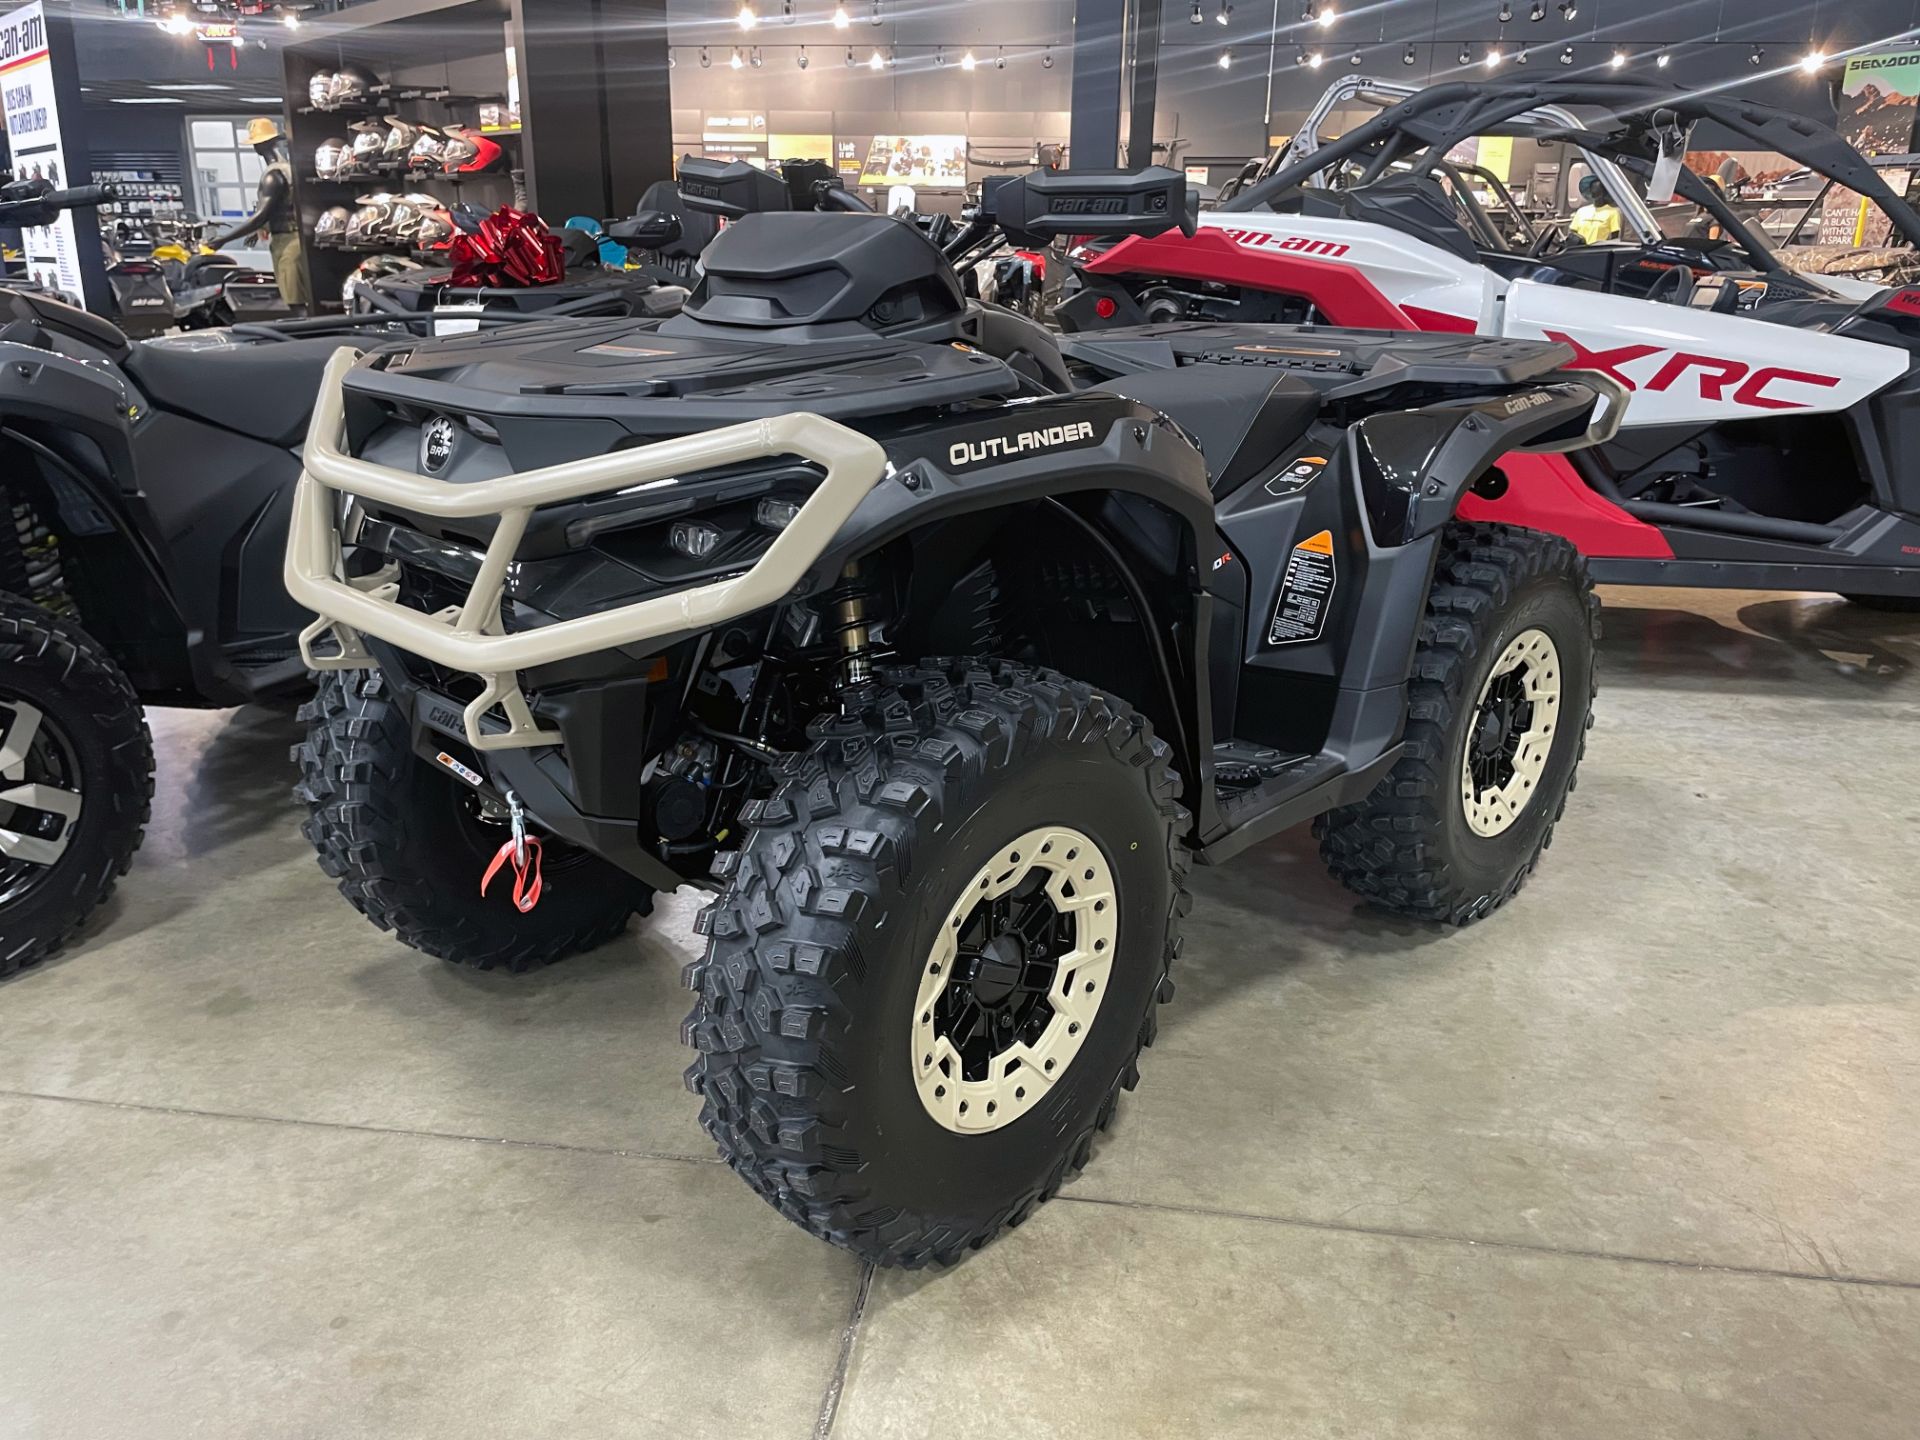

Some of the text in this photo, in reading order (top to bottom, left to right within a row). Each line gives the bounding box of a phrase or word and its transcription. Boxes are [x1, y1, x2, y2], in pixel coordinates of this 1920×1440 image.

[1051, 198, 1124, 213] can-am
[1825, 208, 1873, 217] CAN'T HAE
[1823, 217, 1857, 226] A BLAST
[1822, 227, 1856, 236] WITHOU
[1226, 229, 1350, 257] an-am
[1820, 236, 1852, 245] A SPARK
[1541, 329, 1841, 409] XRC
[1504, 392, 1553, 415] can-am
[429, 445, 449, 457] BRP
[949, 421, 1094, 466] OUTLANDER
[429, 706, 467, 736] can-a
